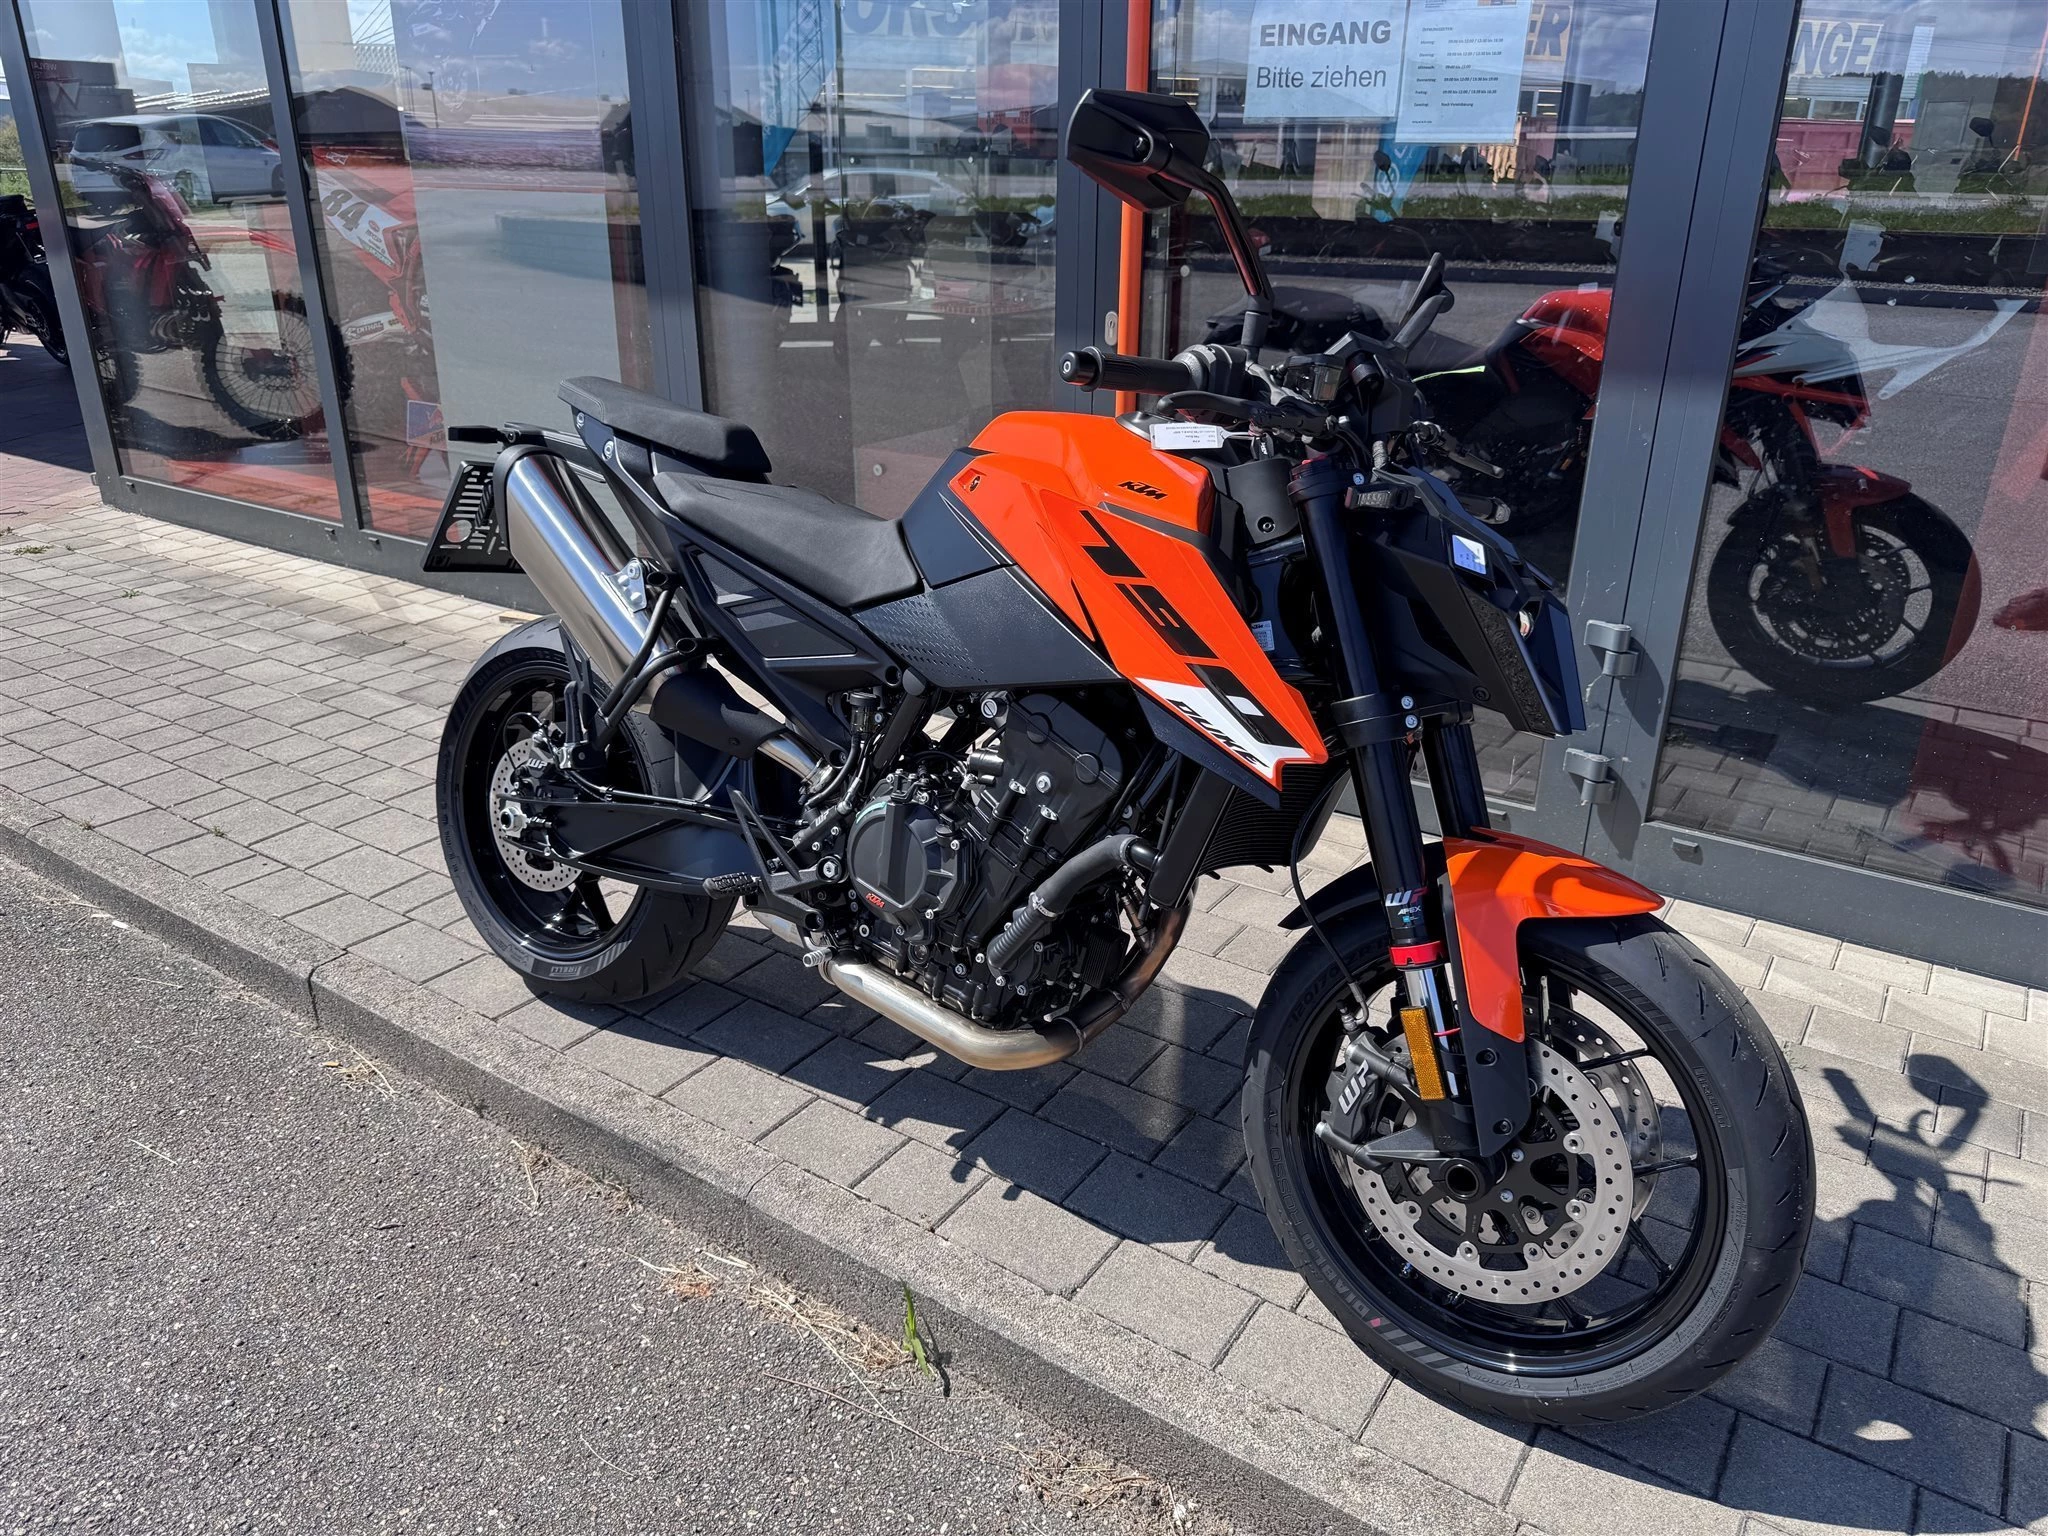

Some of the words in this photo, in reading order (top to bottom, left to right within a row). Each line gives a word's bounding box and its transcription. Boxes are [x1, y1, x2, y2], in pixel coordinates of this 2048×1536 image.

[1259, 20, 1392, 47] EINGANG
[1256, 66, 1304, 89] Bitte
[1311, 65, 1387, 89] ziehen
[322, 189, 369, 232] 84
[1117, 480, 1167, 499] KTM
[1079, 509, 1305, 749] 790
[1166, 698, 1270, 769] DUKE
[526, 758, 548, 768] WP
[865, 892, 886, 908] KTM
[1385, 887, 1428, 906] WP
[1398, 906, 1421, 916] APEX
[548, 965, 583, 977] PIRELLI
[1338, 1059, 1369, 1115] WP
[1270, 1147, 1304, 1226] ROSSO
[1301, 1232, 1370, 1320] DIABLO
